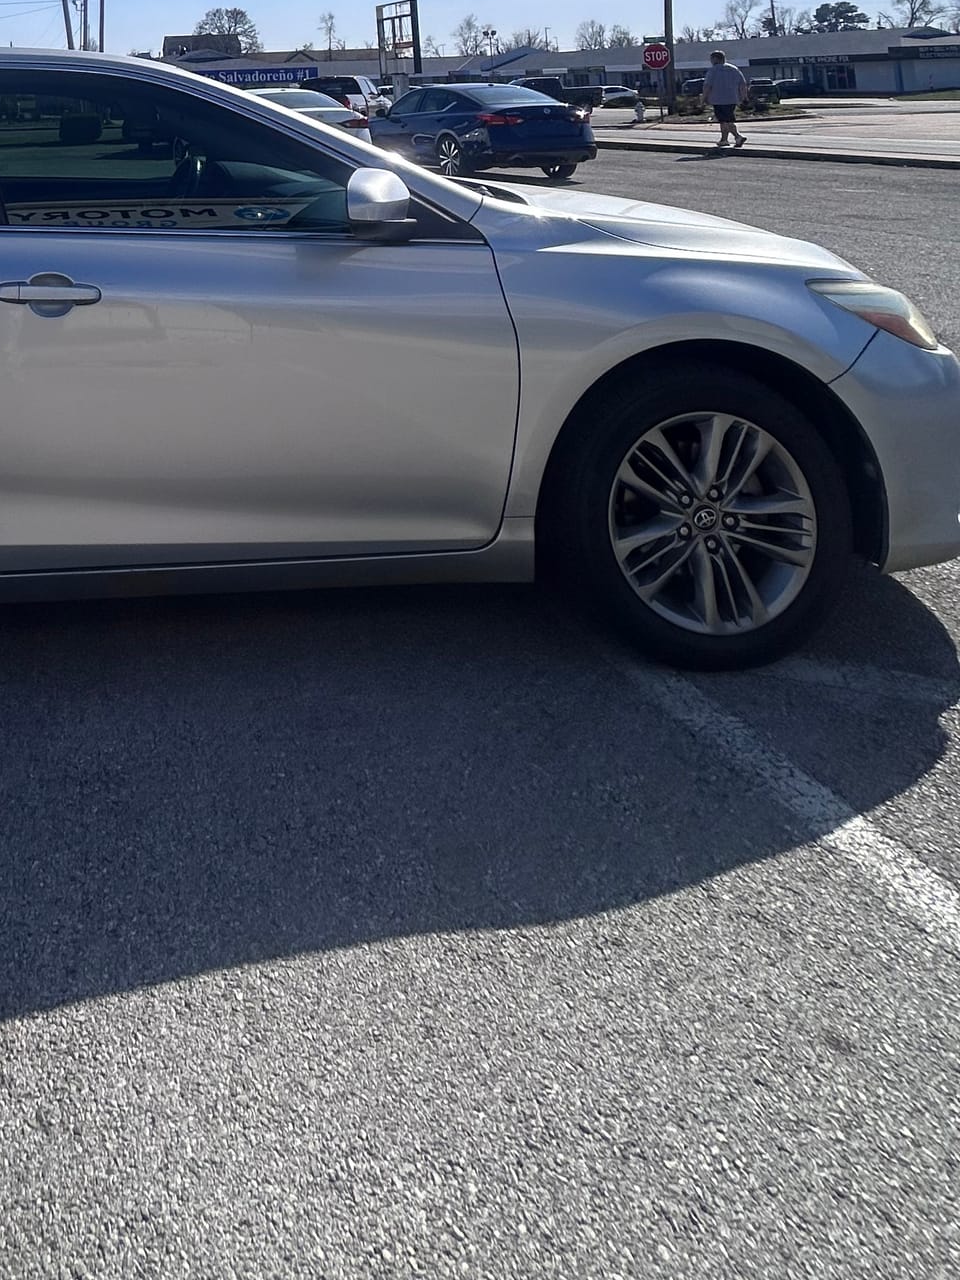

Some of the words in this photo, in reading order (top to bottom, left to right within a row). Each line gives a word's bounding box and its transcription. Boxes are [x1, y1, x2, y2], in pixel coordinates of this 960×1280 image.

[645, 51, 668, 61] STOP
[817, 55, 838, 63] PHONE
[219, 70, 293, 83] Salvadoreño
[297, 69, 310, 81] #1
